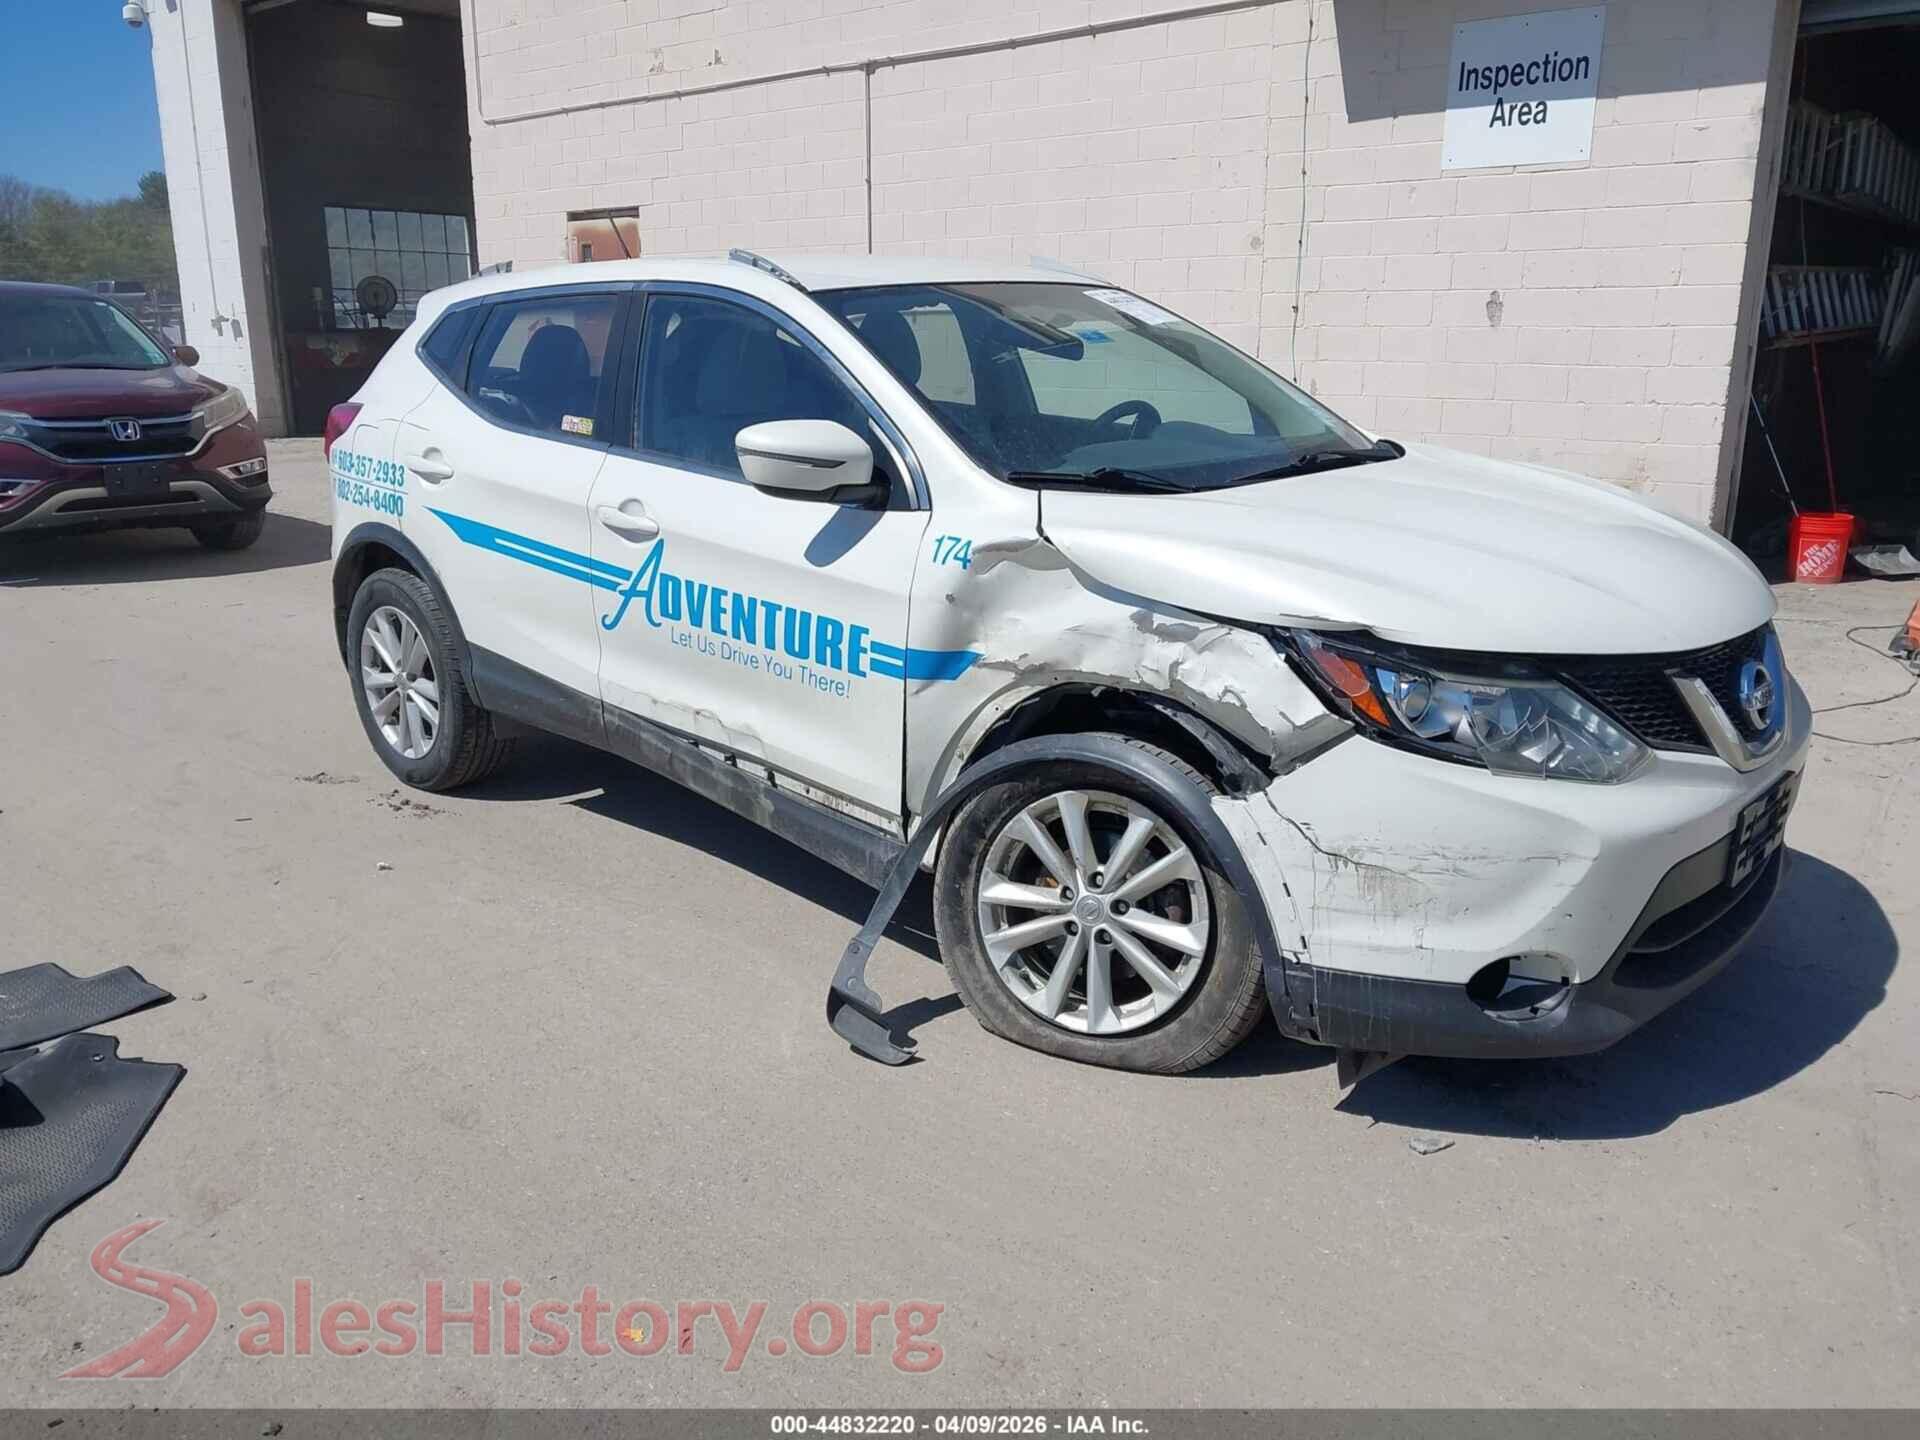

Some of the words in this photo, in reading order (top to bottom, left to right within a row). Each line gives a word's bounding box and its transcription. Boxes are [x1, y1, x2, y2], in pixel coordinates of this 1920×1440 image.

[1458, 51, 1590, 95] Inspection
[1488, 97, 1548, 128] Area
[933, 535, 972, 570] 174
[1799, 540, 1840, 576] HOME
[601, 538, 870, 678] ADVENTURE
[671, 626, 692, 647] Let
[697, 633, 716, 656] Us
[720, 641, 759, 669] Drive
[763, 655, 793, 681] You
[799, 664, 851, 699] There!
